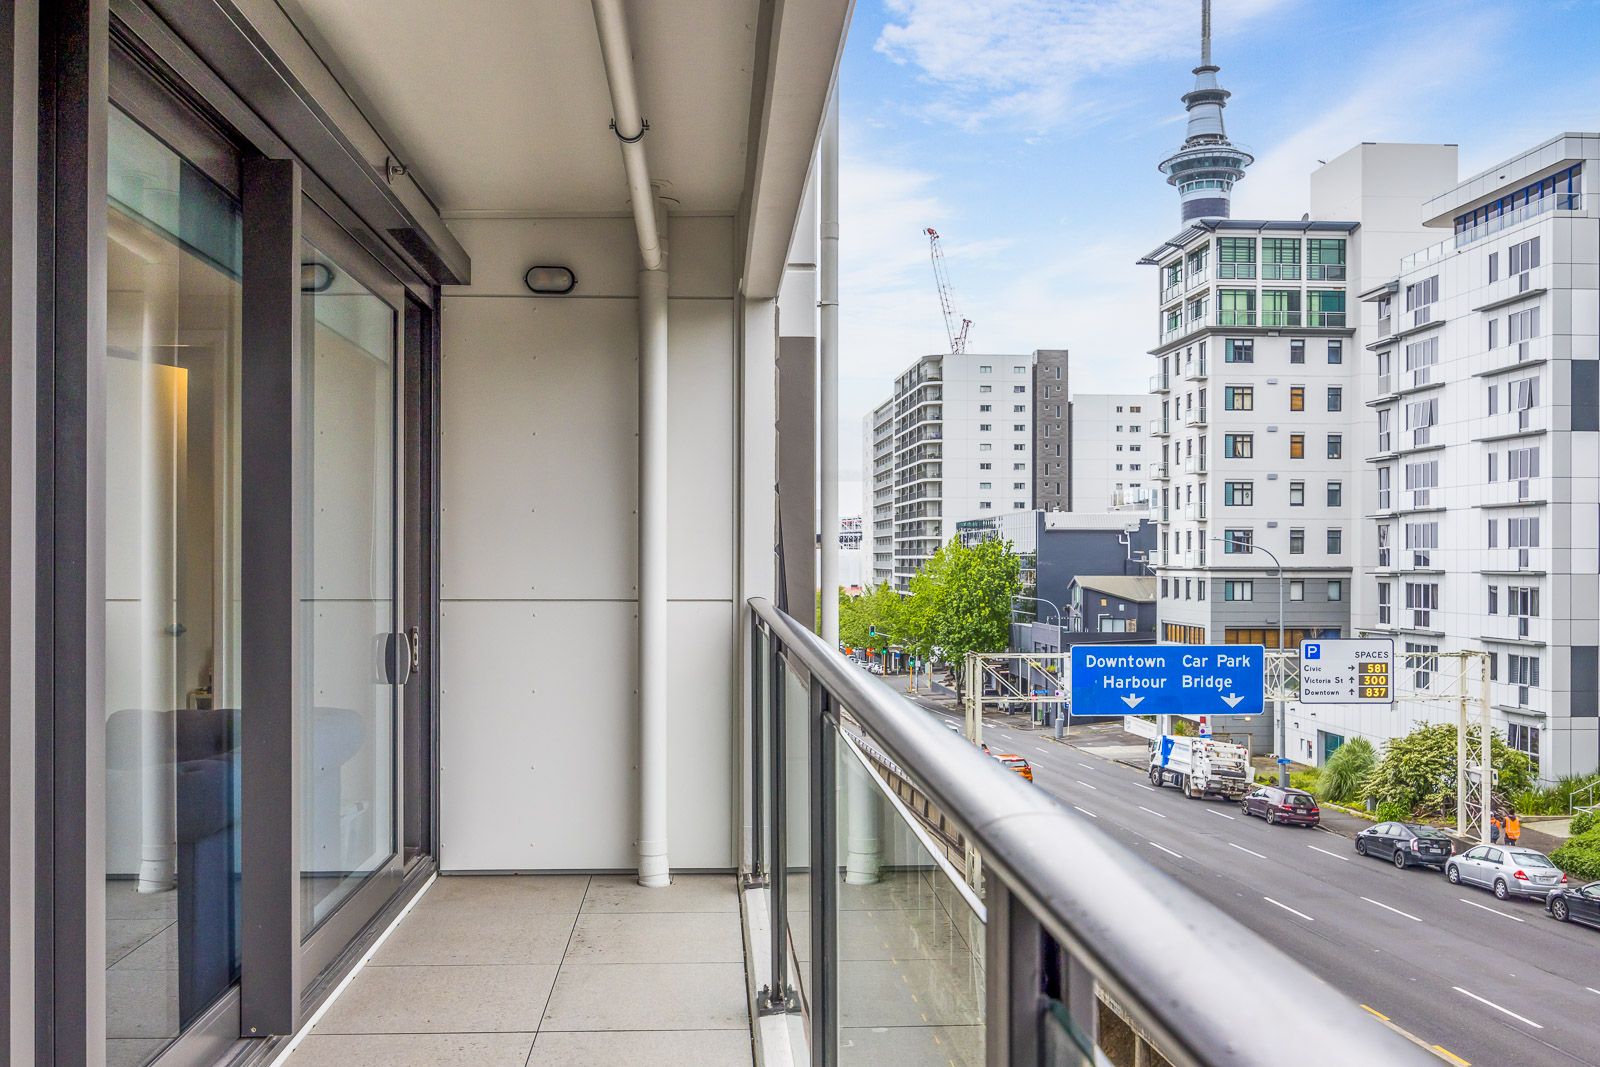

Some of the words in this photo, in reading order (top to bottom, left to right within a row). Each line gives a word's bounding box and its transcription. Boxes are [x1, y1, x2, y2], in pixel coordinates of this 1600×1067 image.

[1307, 646, 1318, 658] P
[1354, 651, 1389, 659] SPACES
[1086, 654, 1166, 668] Downtown
[1182, 654, 1208, 668] Car
[1217, 654, 1251, 668] Park
[1303, 664, 1322, 672] Civic
[1367, 663, 1386, 673] 581
[1103, 675, 1167, 689] Harbour
[1182, 675, 1233, 692] Bridge
[1304, 676, 1331, 684] Victoria
[1334, 676, 1344, 684] St
[1364, 675, 1386, 685] 300
[1304, 688, 1340, 696] Downtown
[1366, 687, 1386, 697] 837
